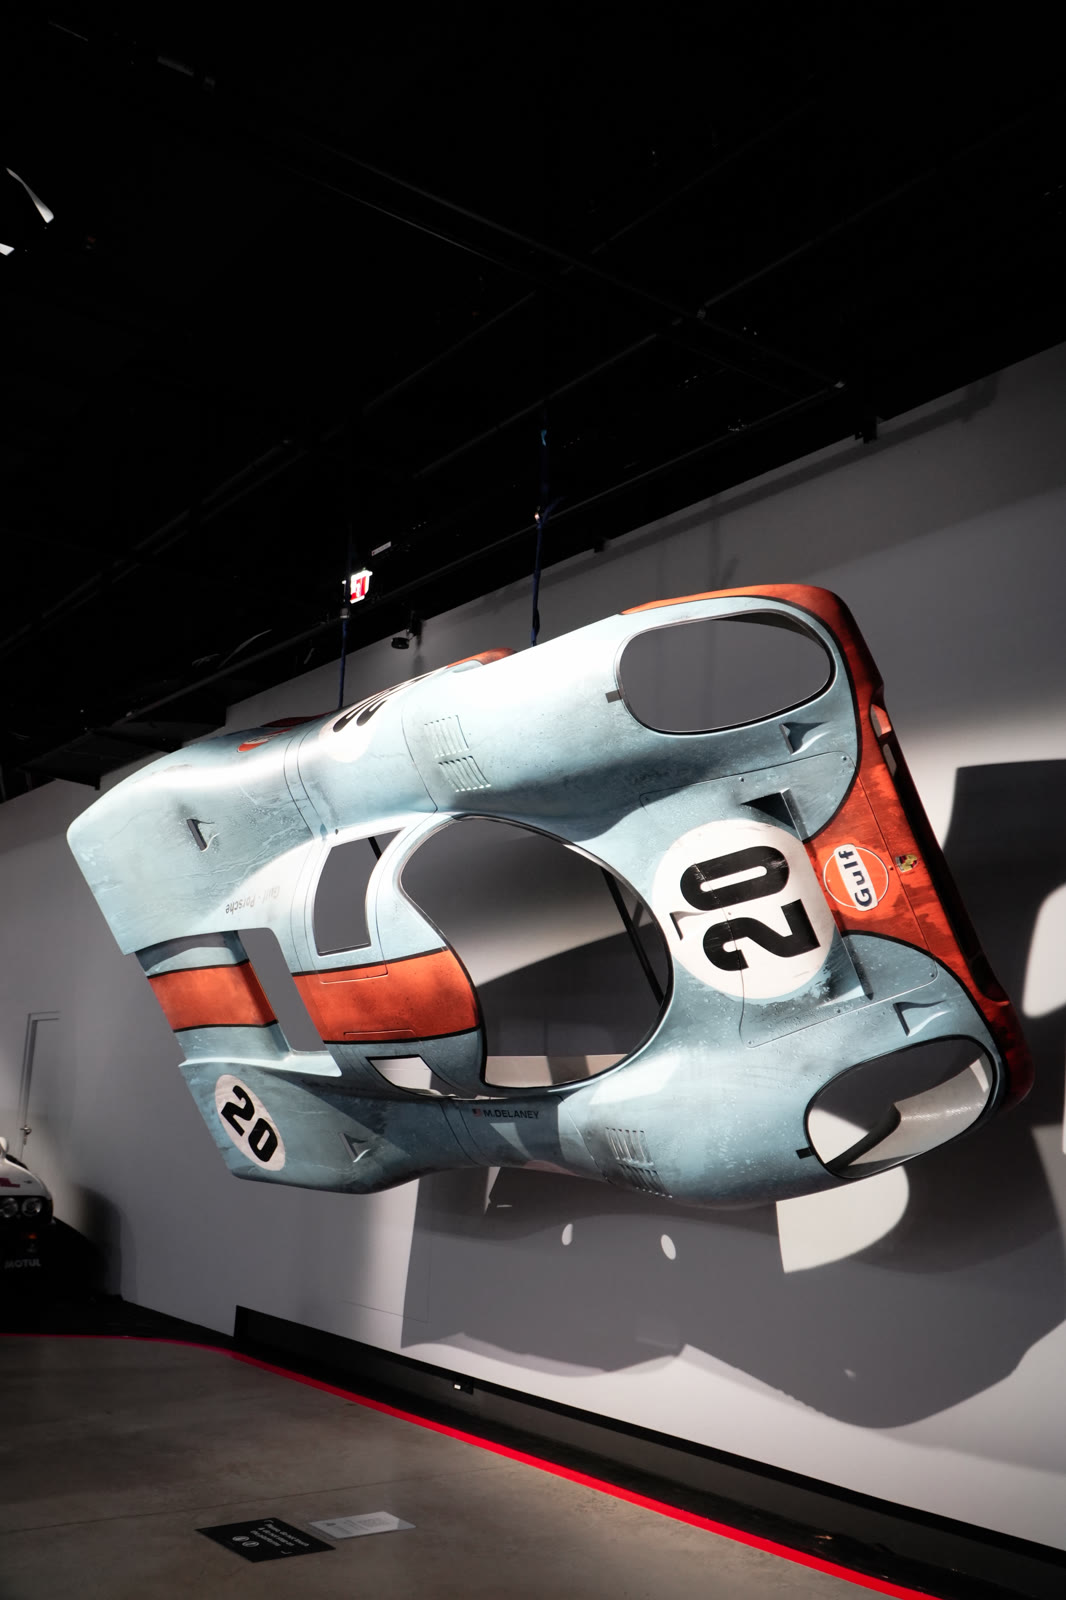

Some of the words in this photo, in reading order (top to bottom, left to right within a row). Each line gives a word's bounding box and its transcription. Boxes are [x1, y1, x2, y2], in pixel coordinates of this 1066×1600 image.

[225, 895, 256, 915] Porsche
[838, 851, 872, 907] Gulf
[680, 846, 821, 971] 20
[221, 1085, 278, 1162] 20
[4, 1258, 42, 1270] MOTUL
